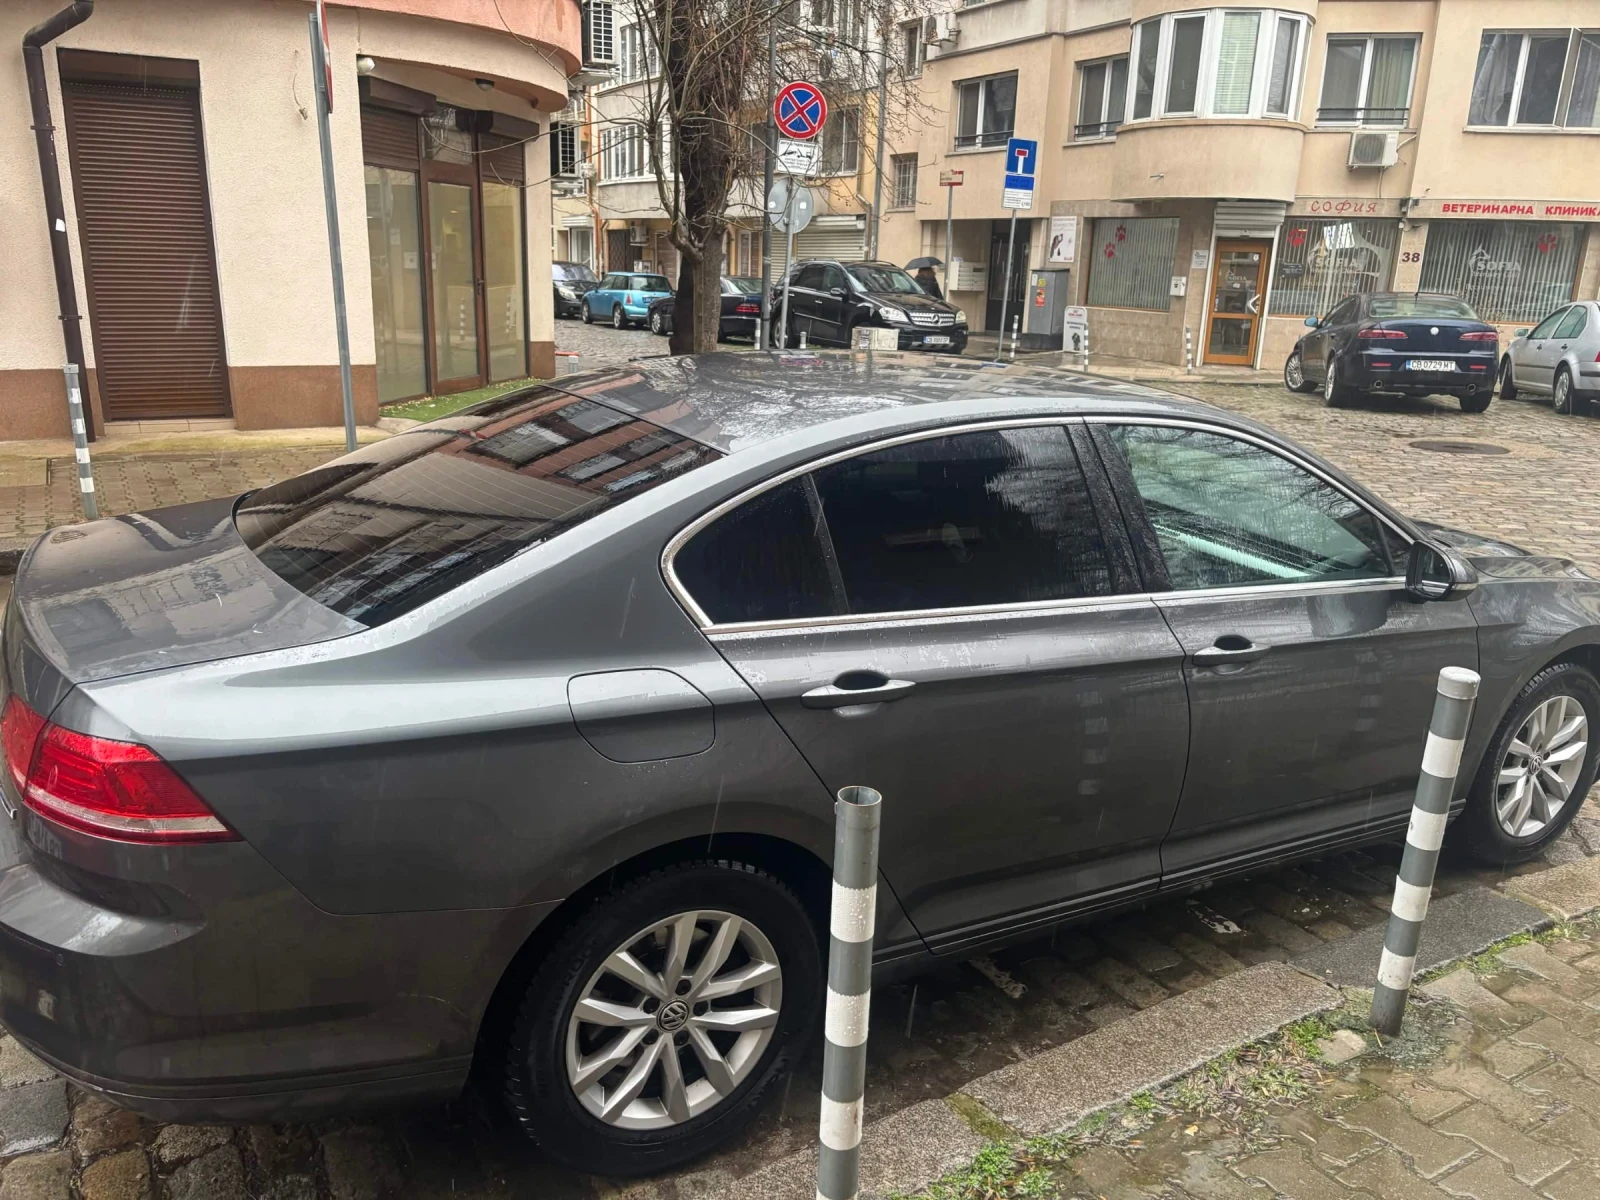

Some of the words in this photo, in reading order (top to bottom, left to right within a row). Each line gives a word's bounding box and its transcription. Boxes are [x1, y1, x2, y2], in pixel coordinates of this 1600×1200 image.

[1311, 199, 1378, 214] СОФИЯ
[1442, 203, 1534, 215] ВЕТЕРИНАРНА
[1545, 205, 1600, 217] КЛИНИК
[1402, 252, 1421, 263] 38
[1477, 261, 1521, 272] SOFIA
[1423, 360, 1442, 369] 0729
